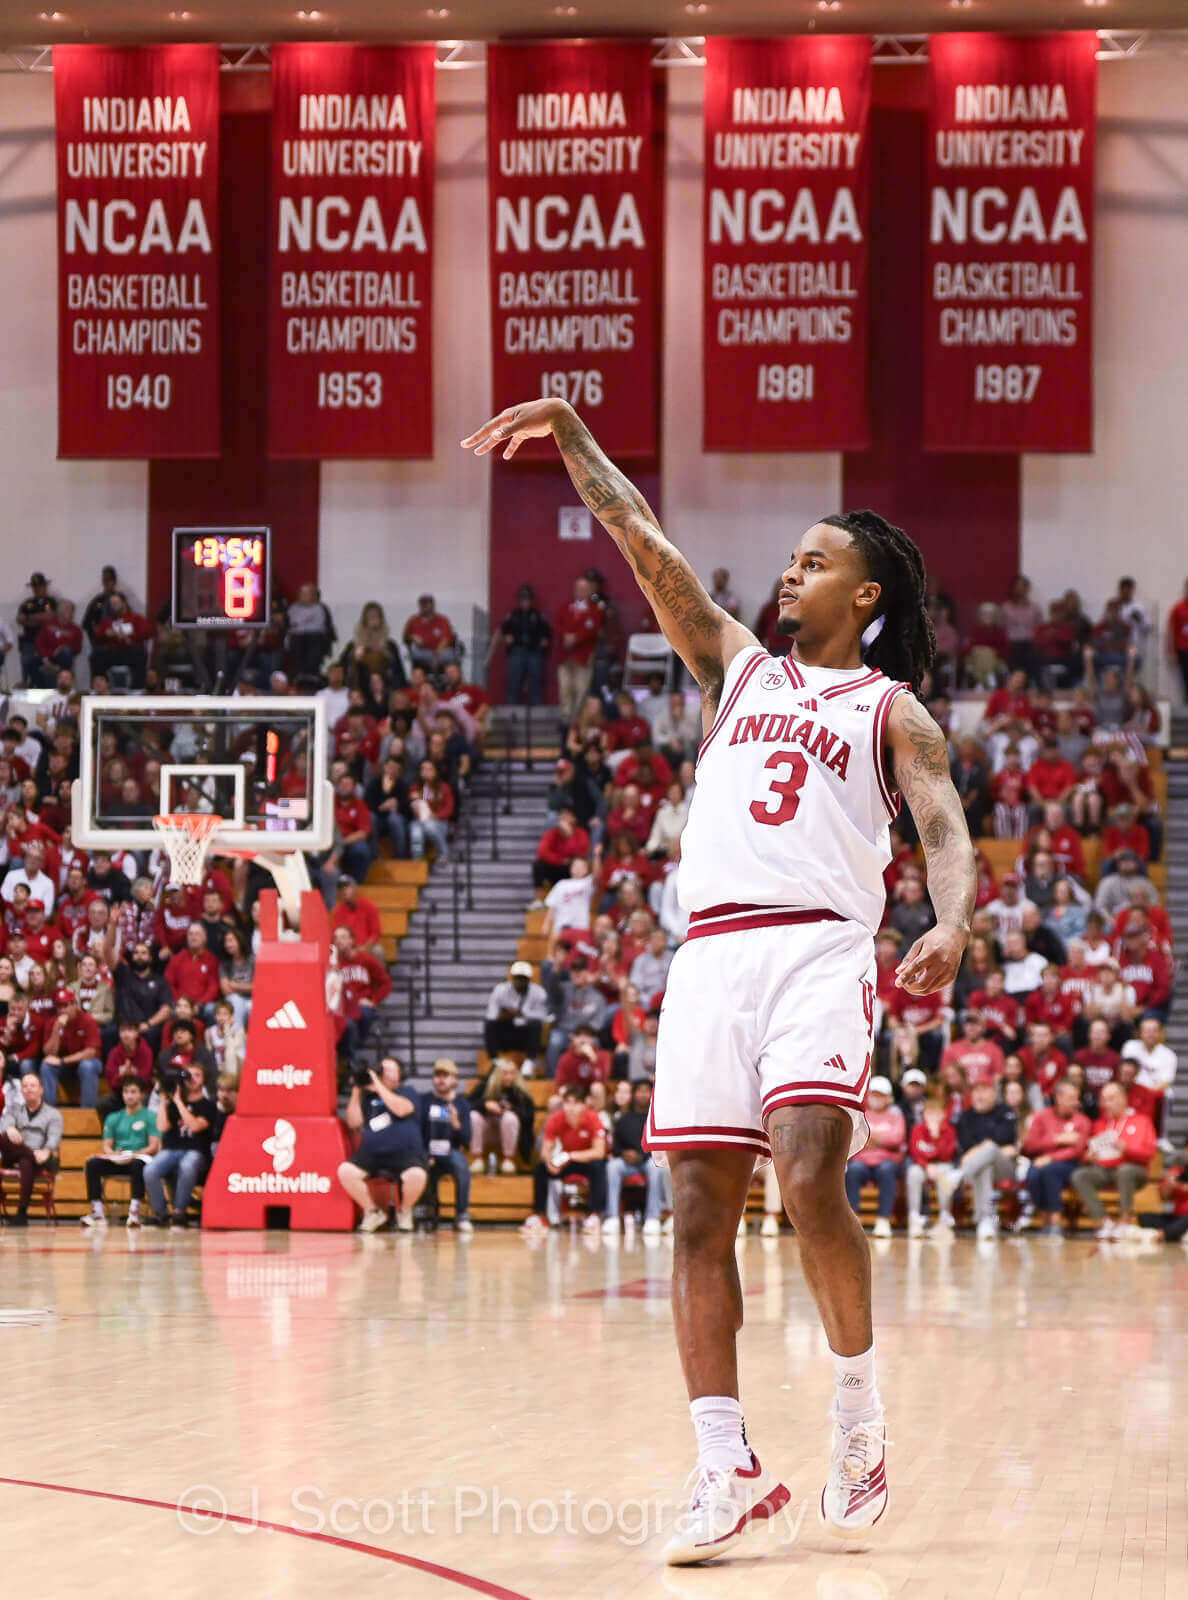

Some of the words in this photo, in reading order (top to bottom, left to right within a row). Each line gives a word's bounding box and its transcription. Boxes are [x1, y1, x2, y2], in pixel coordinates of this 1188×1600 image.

[83, 95, 191, 133] INDIANA
[299, 94, 408, 131] INDIANA
[517, 92, 627, 130] INDIANA
[733, 86, 845, 124] INDIANA
[954, 84, 1068, 122] INDIANA
[67, 141, 207, 178] UNIVERSITY
[283, 139, 422, 176] UNIVERSITY
[499, 135, 643, 177] UNIVERSITY
[714, 132, 860, 169] UNIVERSITY
[936, 129, 1085, 167] UNIVERSITY
[65, 198, 212, 255] NCAA
[278, 196, 427, 253] NCAA
[495, 193, 646, 253] NCAA
[709, 187, 863, 245] NCAA
[930, 186, 1087, 244] NCAA
[67, 274, 207, 311] BASKETBALL
[281, 270, 421, 308] BASKETBALL
[498, 268, 640, 309] BASKETBALL
[712, 261, 857, 300] BASKETBALL
[933, 261, 1082, 300] BASKETBALL
[73, 318, 202, 355] CHAMPIONS
[286, 316, 417, 354] CHAMPIONS
[504, 313, 634, 354] CHAMPIONS
[717, 305, 852, 346] CHAMPIONS
[940, 307, 1077, 345] CHAMPIONS
[107, 374, 171, 410] 1940
[318, 371, 383, 408] 1953
[541, 370, 604, 407] 1976
[757, 364, 814, 401] 1981
[975, 364, 1042, 403] 1987
[194, 537, 262, 568] 13:54
[224, 567, 255, 618] 8
[728, 713, 852, 782] INDIANA
[749, 750, 809, 827] 3
[256, 1064, 313, 1090] meijer
[227, 1172, 331, 1194] Smithville
